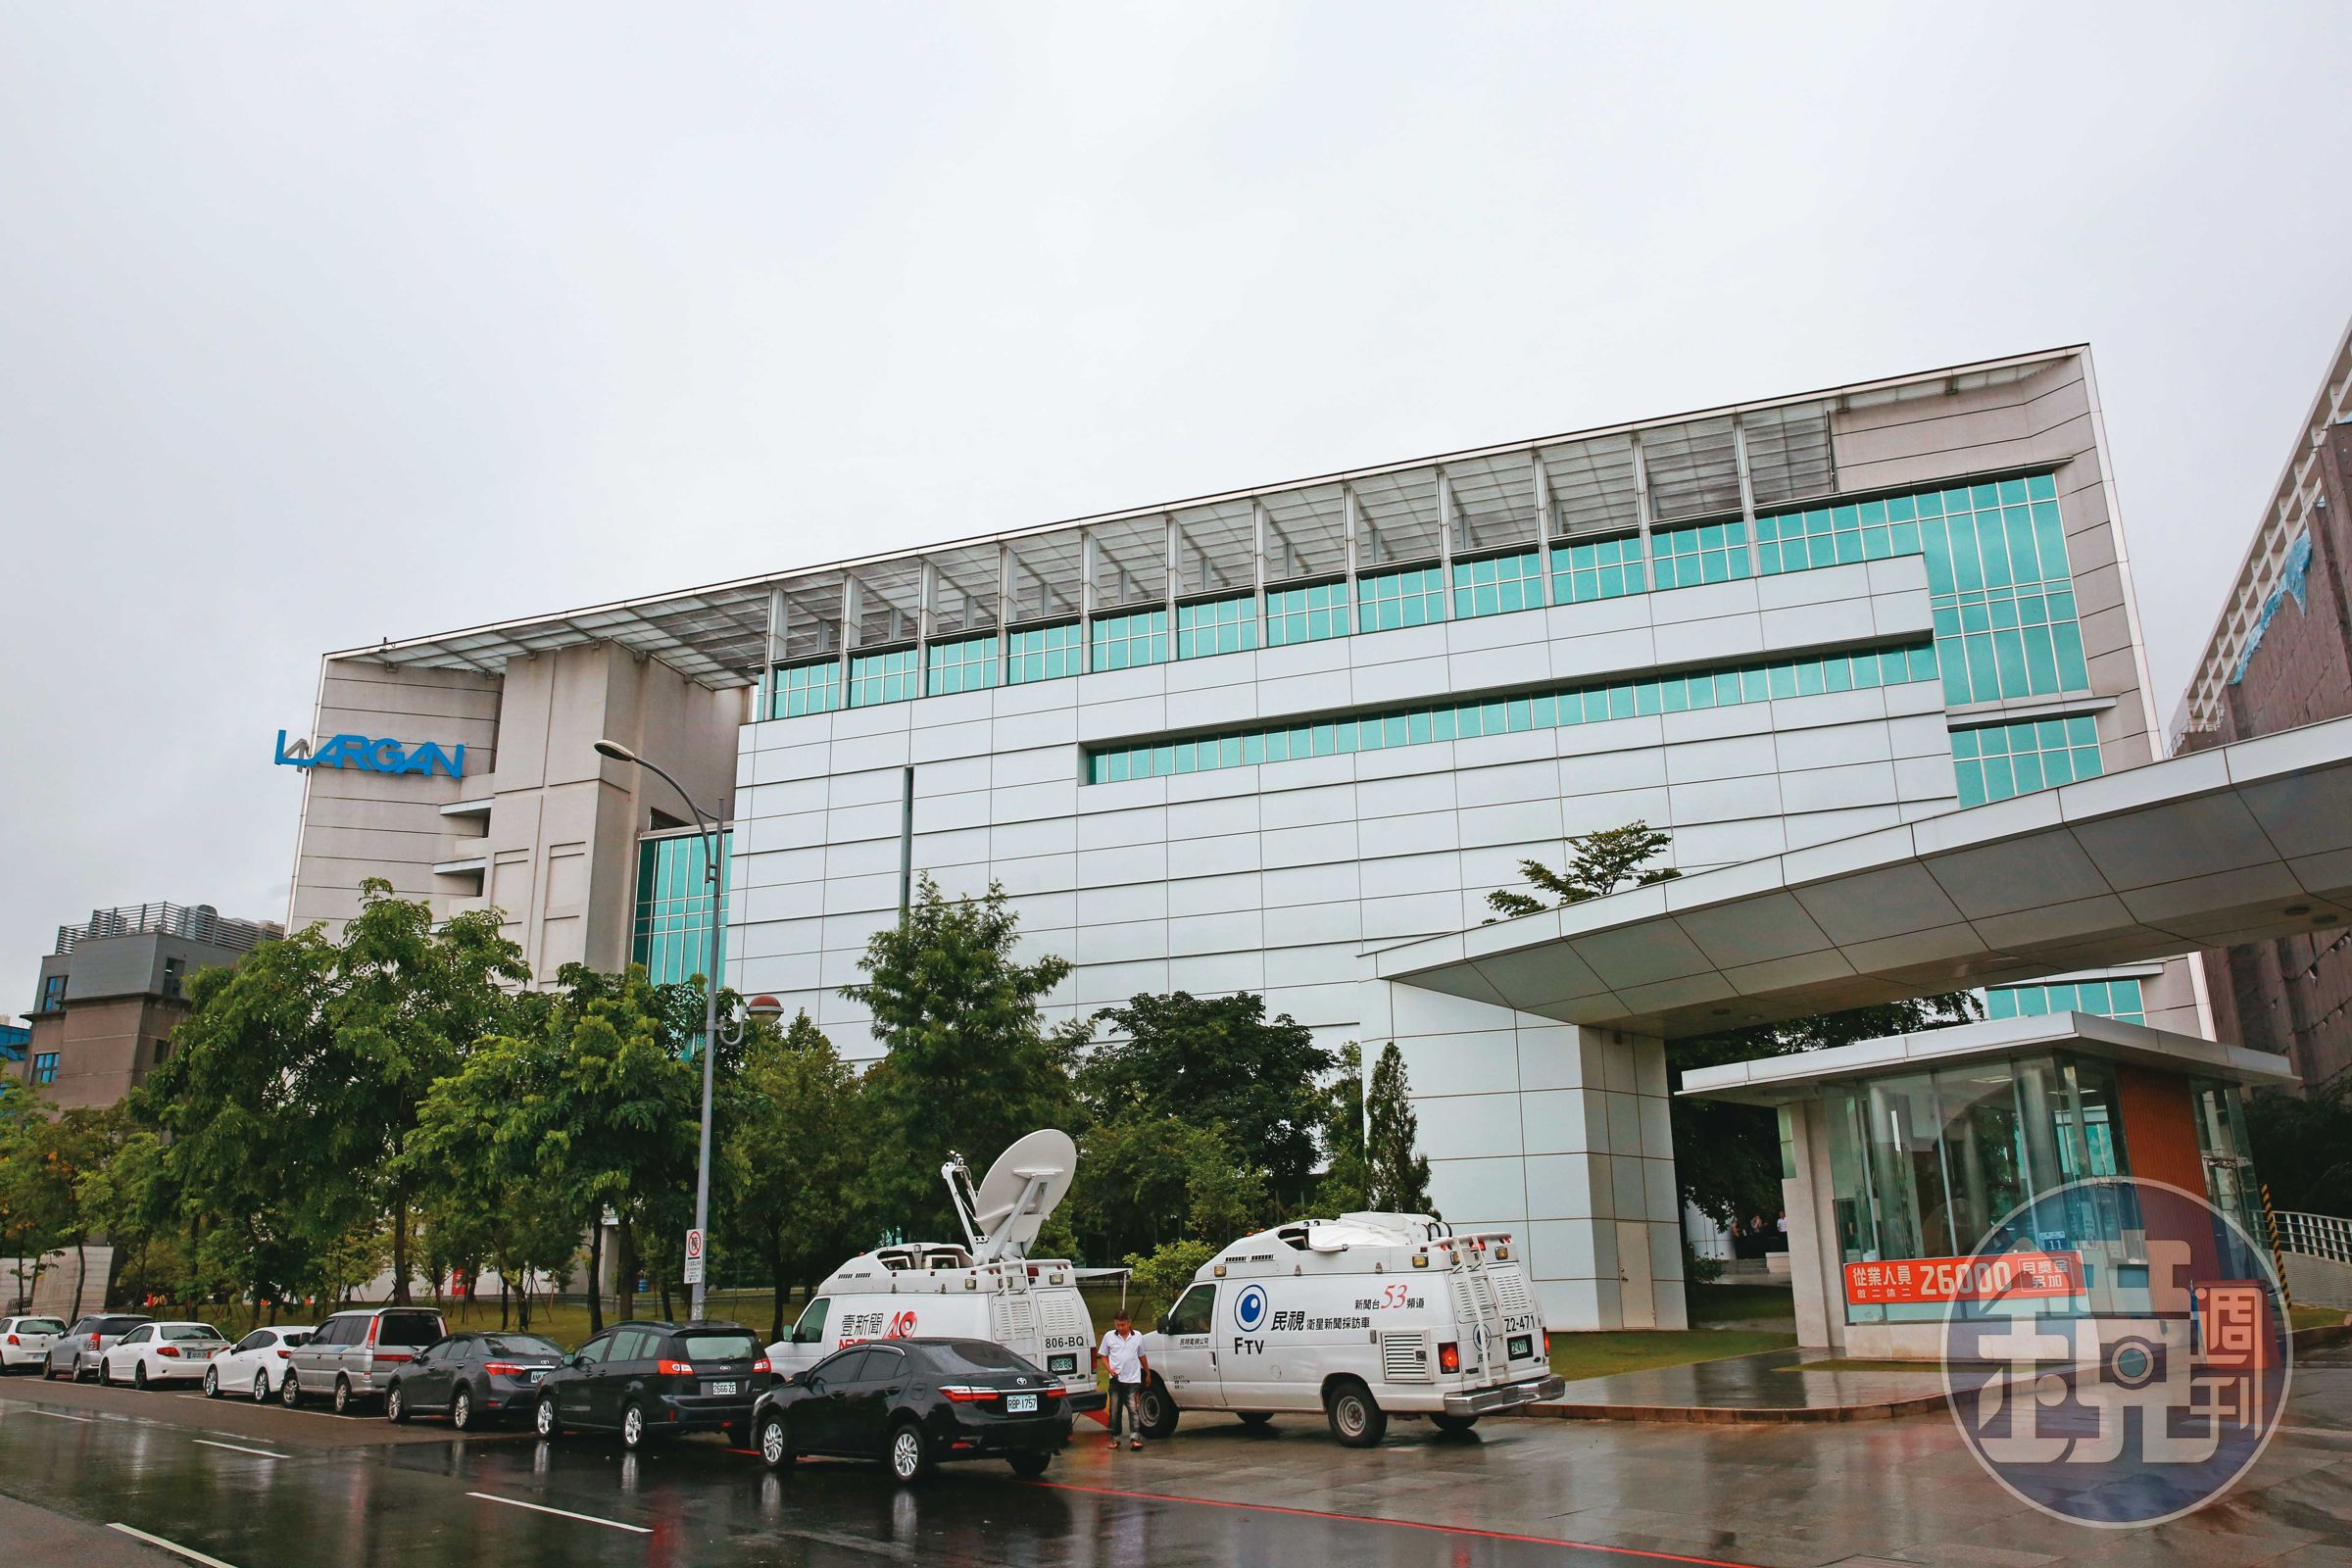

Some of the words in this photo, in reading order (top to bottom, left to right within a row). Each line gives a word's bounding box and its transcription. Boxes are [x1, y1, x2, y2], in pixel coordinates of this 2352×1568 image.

[274, 729, 465, 780] LARGAN
[1852, 1265, 1913, 1286] 從業人員
[1920, 1260, 2012, 1296] 26000
[841, 1313, 883, 1337] 壹新聞
[1271, 1310, 1305, 1331] 民視
[1306, 1317, 1370, 1330] 衛星新聞採訪車
[1504, 1314, 1536, 1332] Z2-471
[1045, 1336, 1085, 1348] 806-BQ
[1234, 1337, 1264, 1354] FTV
